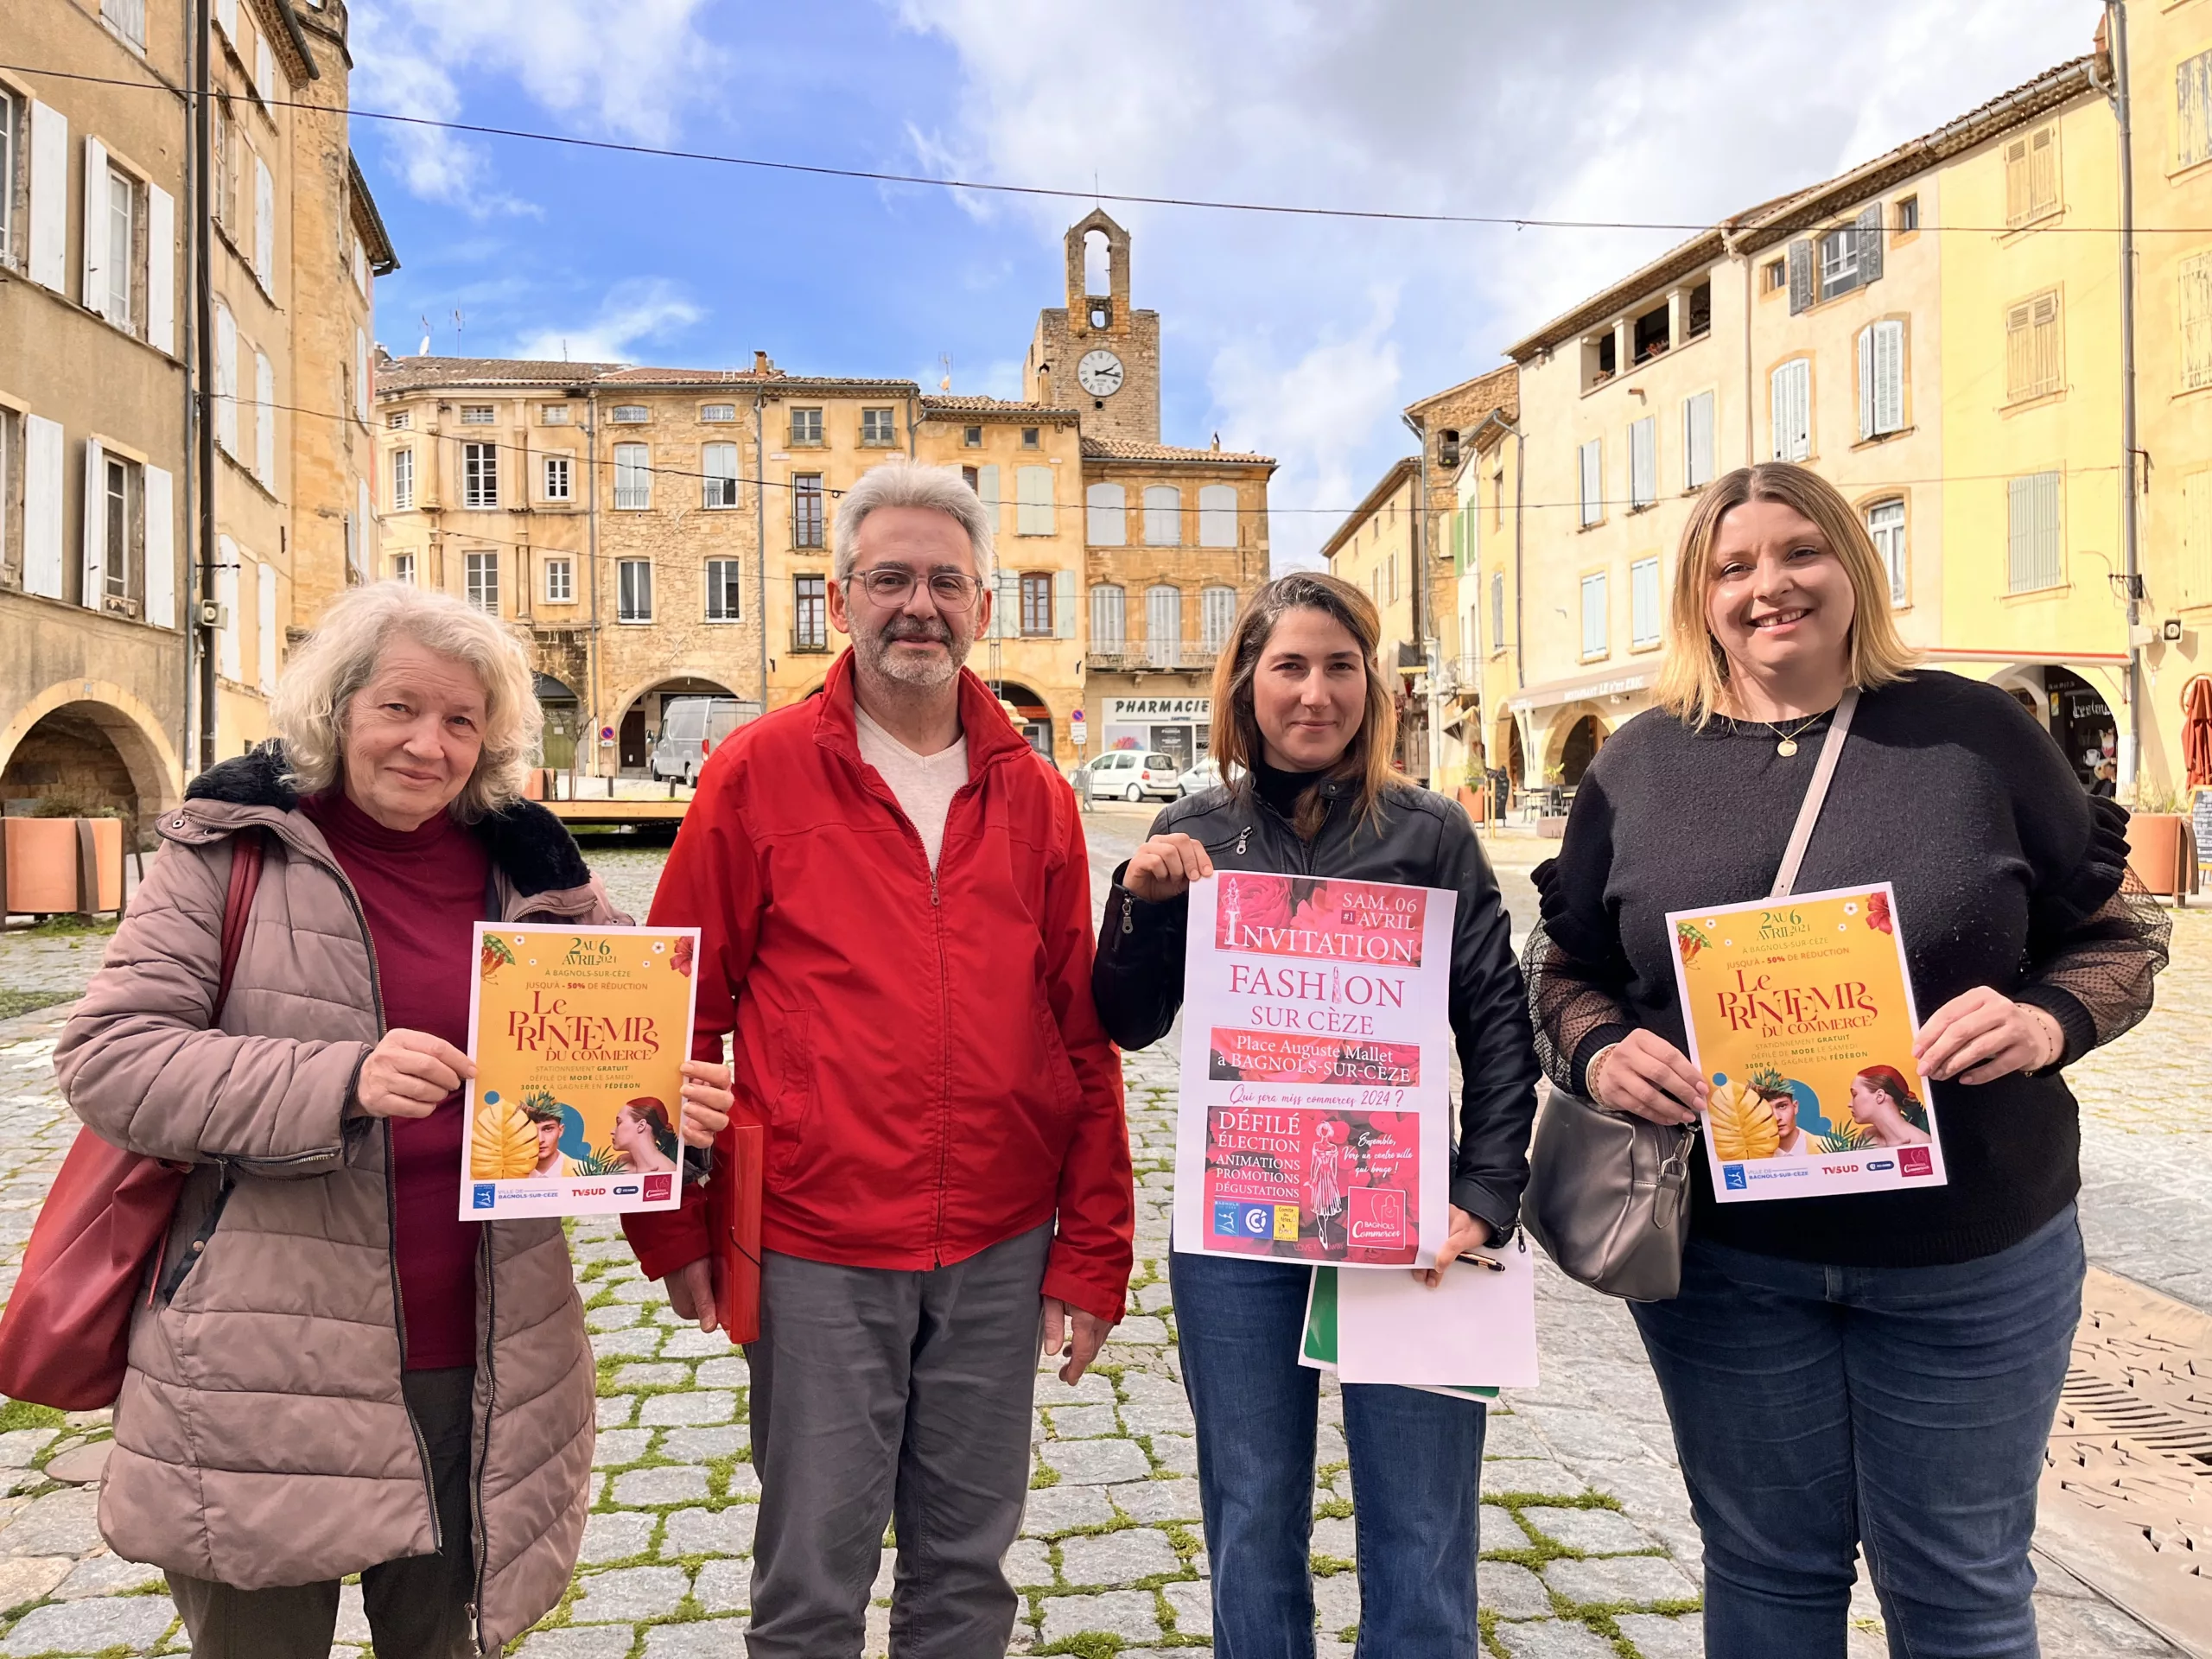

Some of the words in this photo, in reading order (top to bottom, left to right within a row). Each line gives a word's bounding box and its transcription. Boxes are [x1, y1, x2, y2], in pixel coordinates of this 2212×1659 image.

[1116, 700, 1209, 713] PHARMACIE
[1343, 893, 1389, 911] SAM.
[1395, 898, 1417, 912] 06
[1344, 912, 1354, 922] #1
[1358, 912, 1415, 930] AVRIL
[1760, 912, 1771, 929] 2
[1771, 912, 1788, 924] AU
[1789, 909, 1802, 925] 6
[1224, 911, 1414, 963] INVITATION
[1757, 927, 1795, 941] AVRIL
[569, 938, 581, 954] 2
[581, 941, 598, 950] AU
[600, 939, 610, 955] 6
[1751, 938, 1828, 952] BAGNOLS-SUR-CÈZE
[1801, 947, 1849, 959] RÉDUCTION
[563, 954, 601, 965] AVRIL
[553, 969, 631, 977] BAGNOLS-SUR-CÈZE
[1736, 969, 1771, 993] Le
[533, 991, 567, 1014] Le
[1717, 982, 1878, 1031] PRINTEMPS
[1251, 1006, 1300, 1028] SUR
[1307, 1007, 1374, 1034] CÈZE
[1762, 1026, 1783, 1038] DU
[1788, 1015, 1872, 1034] COMMERCE
[508, 1011, 658, 1054] PRINTEMPS
[1756, 1039, 1815, 1050] STATIONNEMENT
[1817, 1034, 1850, 1043] GRATUIT
[546, 1051, 567, 1061] DU
[572, 1050, 652, 1061] COMMERCE
[1236, 1036, 1275, 1052] Place
[1280, 1039, 1340, 1060] Auguste
[1345, 1046, 1393, 1062] Mallet
[1217, 1054, 1225, 1066] à
[1230, 1053, 1410, 1083] BAGNOLS-SUR-CÈZE
[1230, 1084, 1254, 1104] Qui
[1258, 1091, 1276, 1104] sera
[1281, 1091, 1303, 1106] miss
[1306, 1095, 1356, 1107] commerces
[1361, 1090, 1389, 1106] 2024
[1395, 1090, 1404, 1108] ?
[1218, 1109, 1300, 1135] DÉFILÉ
[1217, 1134, 1300, 1154] ÉLECTION
[1216, 1154, 1300, 1171] ANIMATIONS
[1216, 1168, 1300, 1184] PROMOTIONS
[1215, 1180, 1300, 1198] DÉGUSTATIONS
